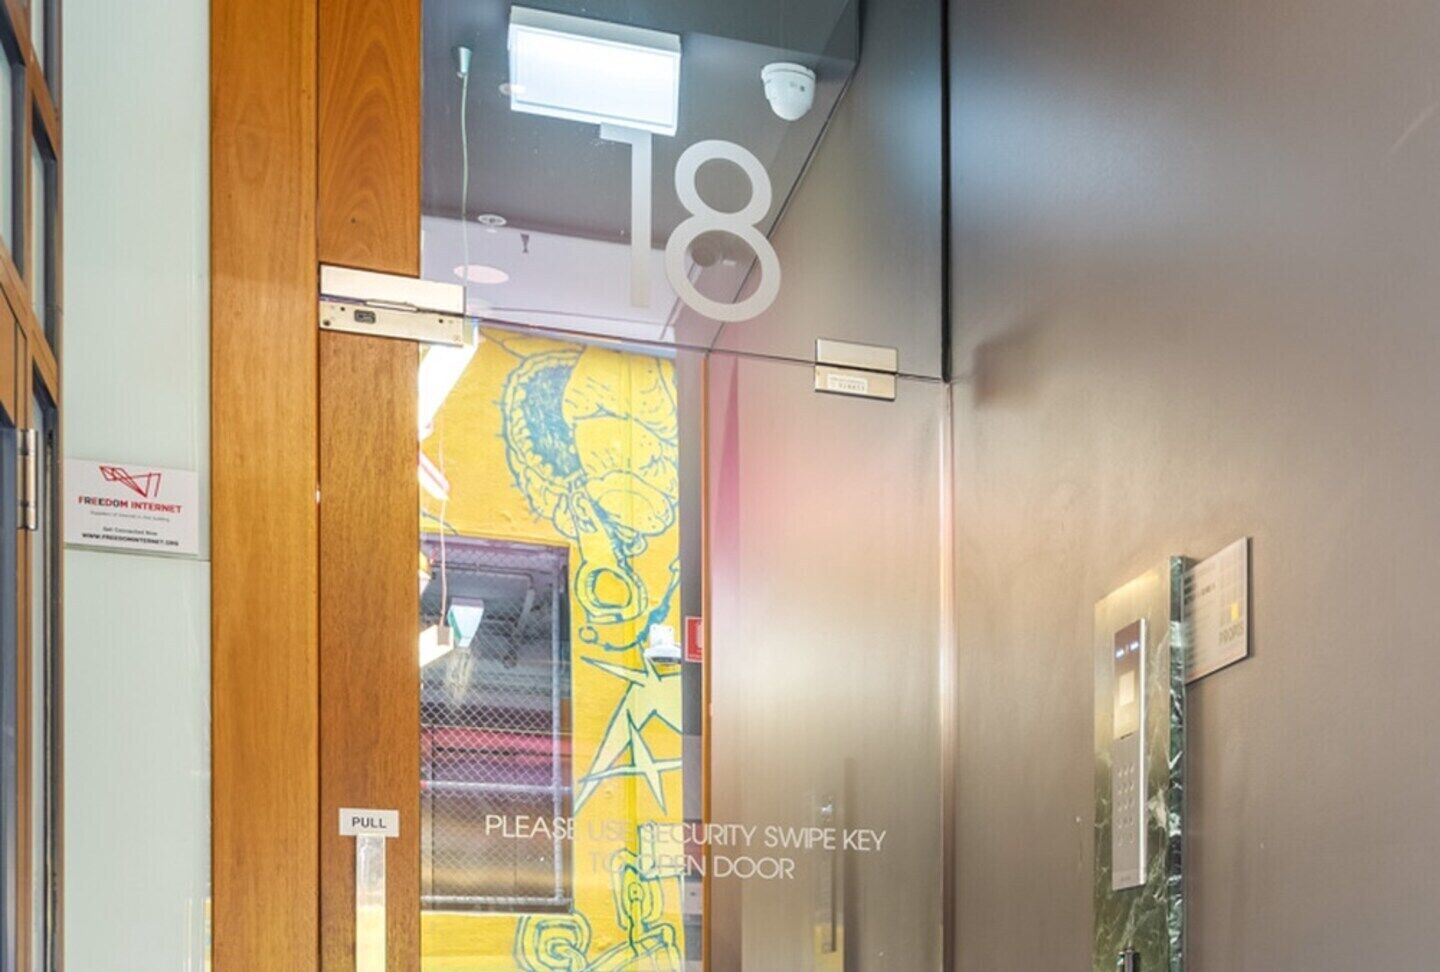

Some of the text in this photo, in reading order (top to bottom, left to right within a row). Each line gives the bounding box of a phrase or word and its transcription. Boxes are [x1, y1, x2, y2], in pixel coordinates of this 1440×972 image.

[600, 121, 781, 322] 18
[78, 496, 182, 513] FREEDOM INTERNET
[352, 816, 387, 829] PULL
[485, 813, 577, 841] PLEASE
[642, 820, 757, 848] SECURITY
[764, 825, 836, 851] SWIPE
[843, 828, 888, 851] KEY
[713, 855, 796, 880] DOOR
